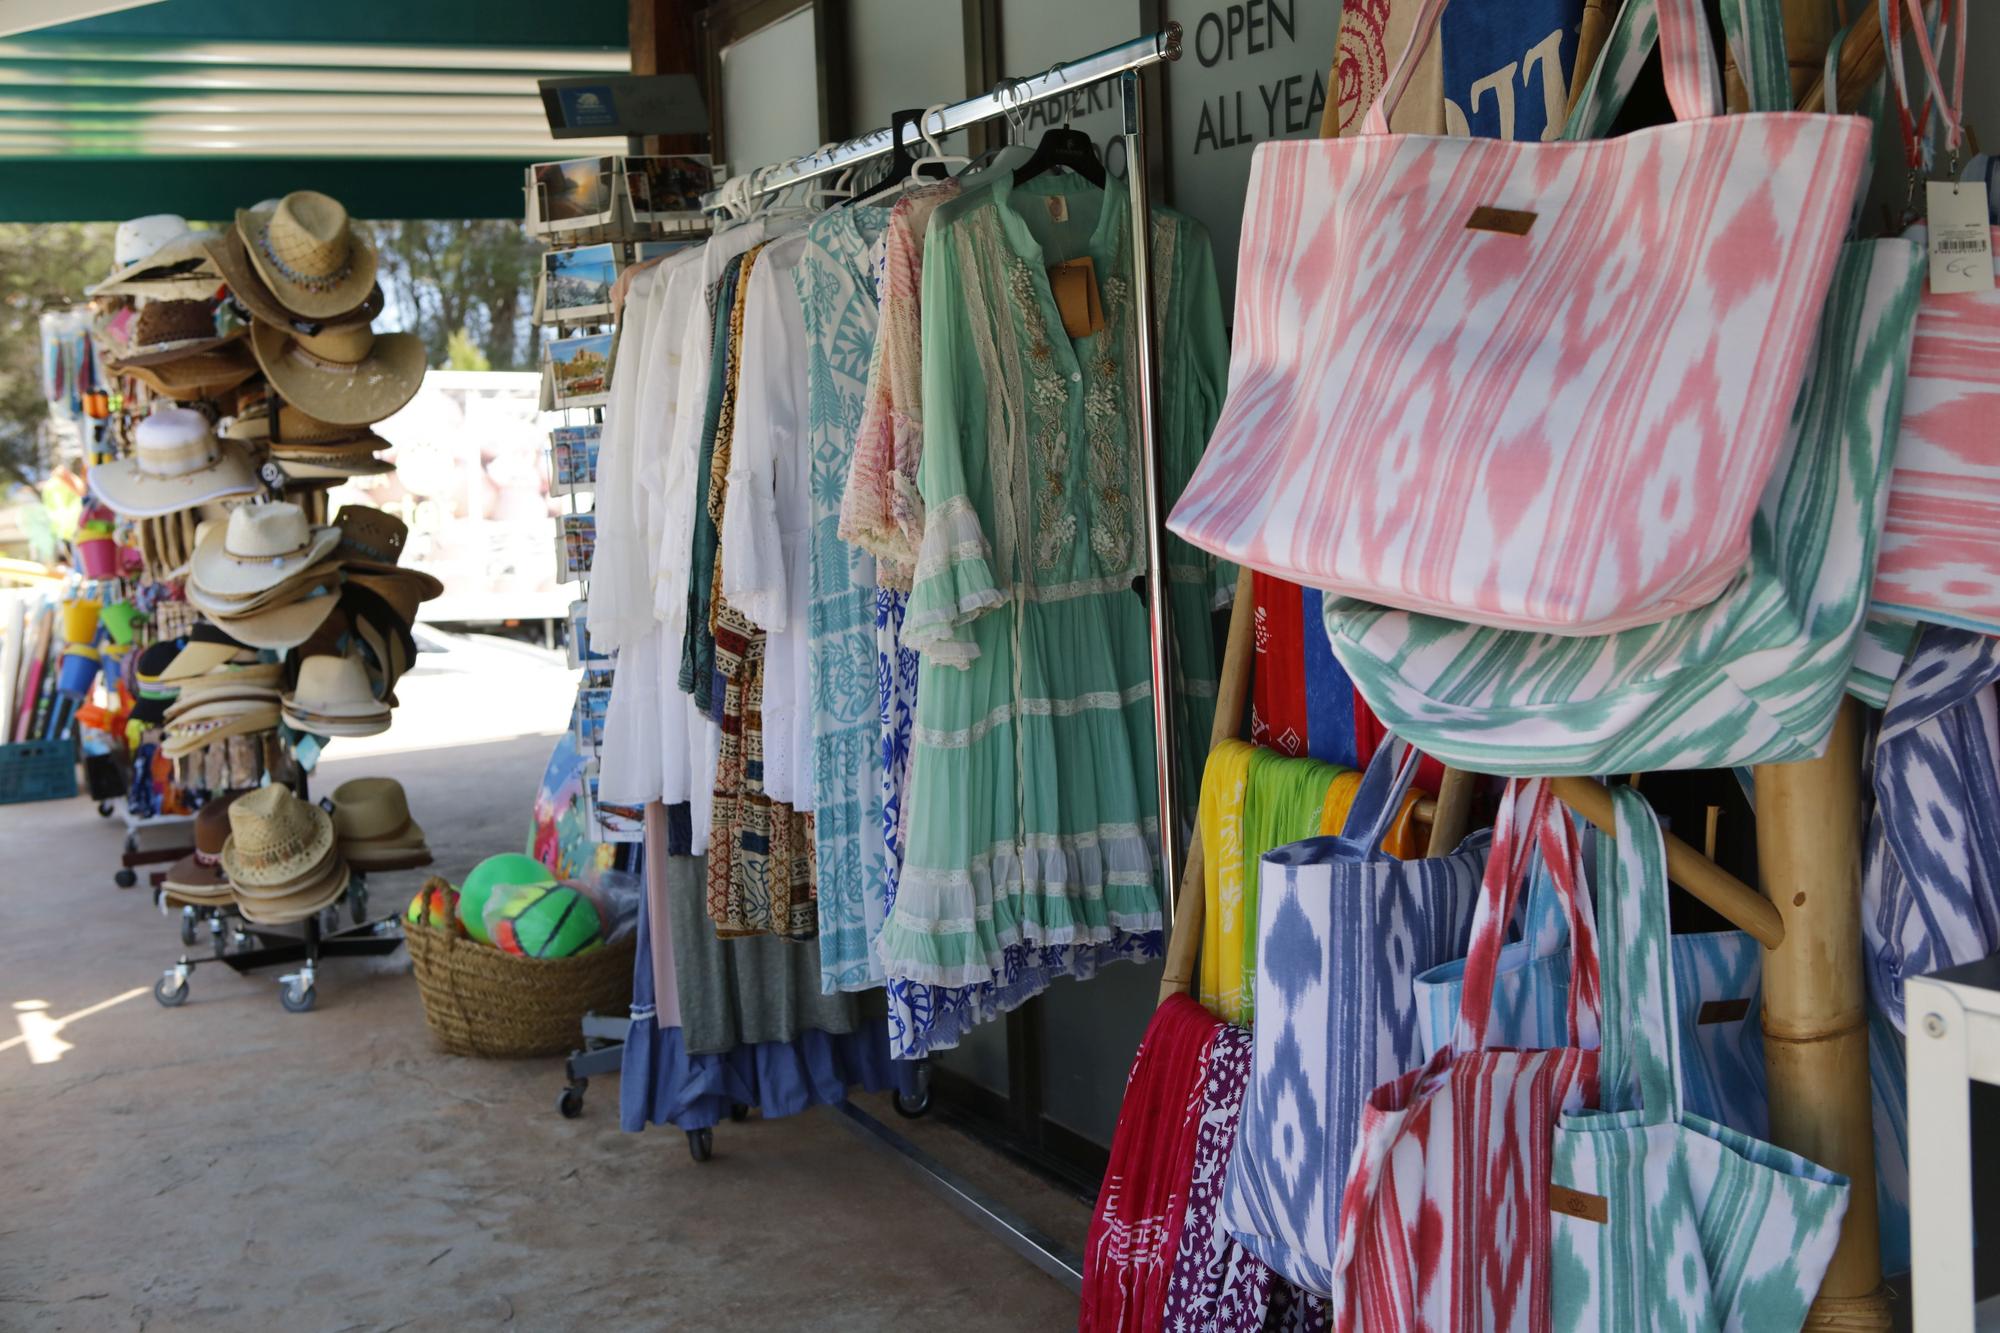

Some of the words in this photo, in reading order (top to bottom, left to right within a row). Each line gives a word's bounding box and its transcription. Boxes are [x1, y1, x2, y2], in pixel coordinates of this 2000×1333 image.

[1196, 0, 1295, 67] OPEN
[1194, 91, 1252, 154] ALL
[1259, 69, 1326, 137] YEA
